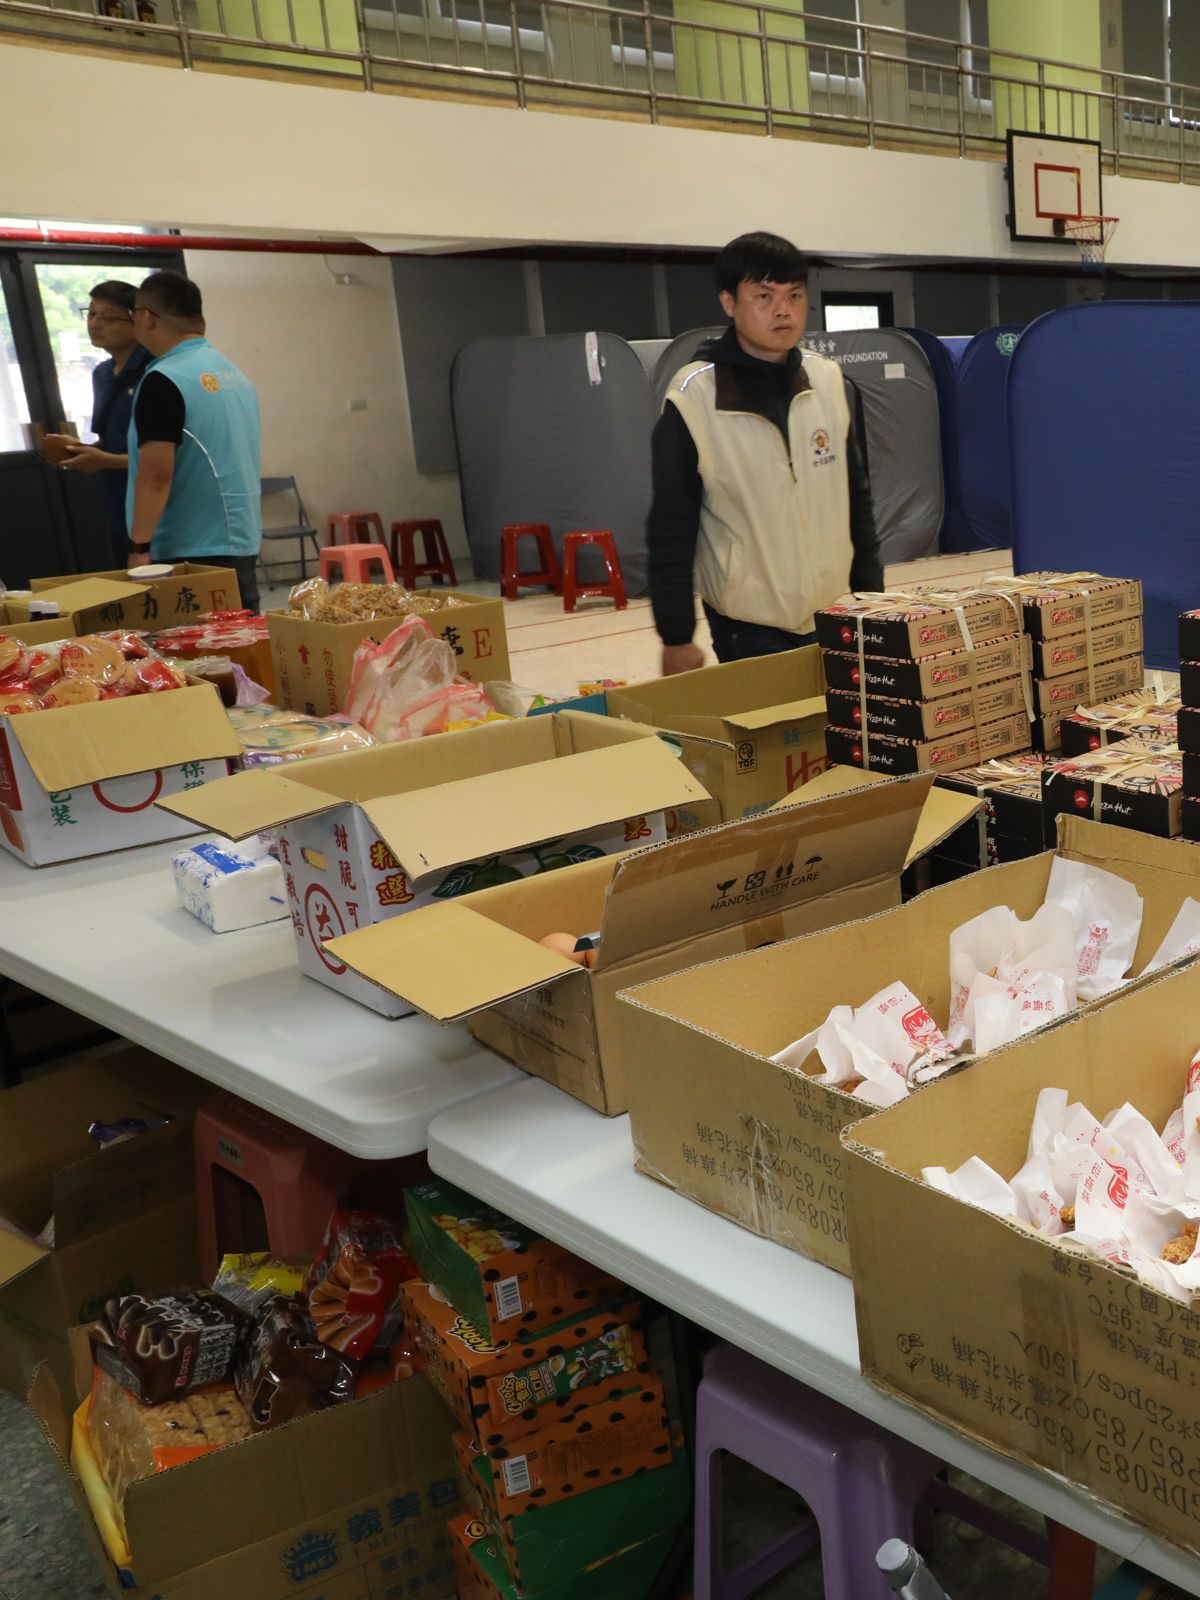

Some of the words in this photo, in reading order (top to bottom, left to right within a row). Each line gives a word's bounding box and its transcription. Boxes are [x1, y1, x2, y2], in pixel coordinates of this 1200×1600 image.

[843, 351, 888, 364] FOUNDATION
[472, 628, 493, 659] E
[710, 890, 759, 912] HANDLE
[760, 880, 790, 897] WITH
[790, 871, 820, 887] CARE
[500, 1377, 523, 1412] Cheetos
